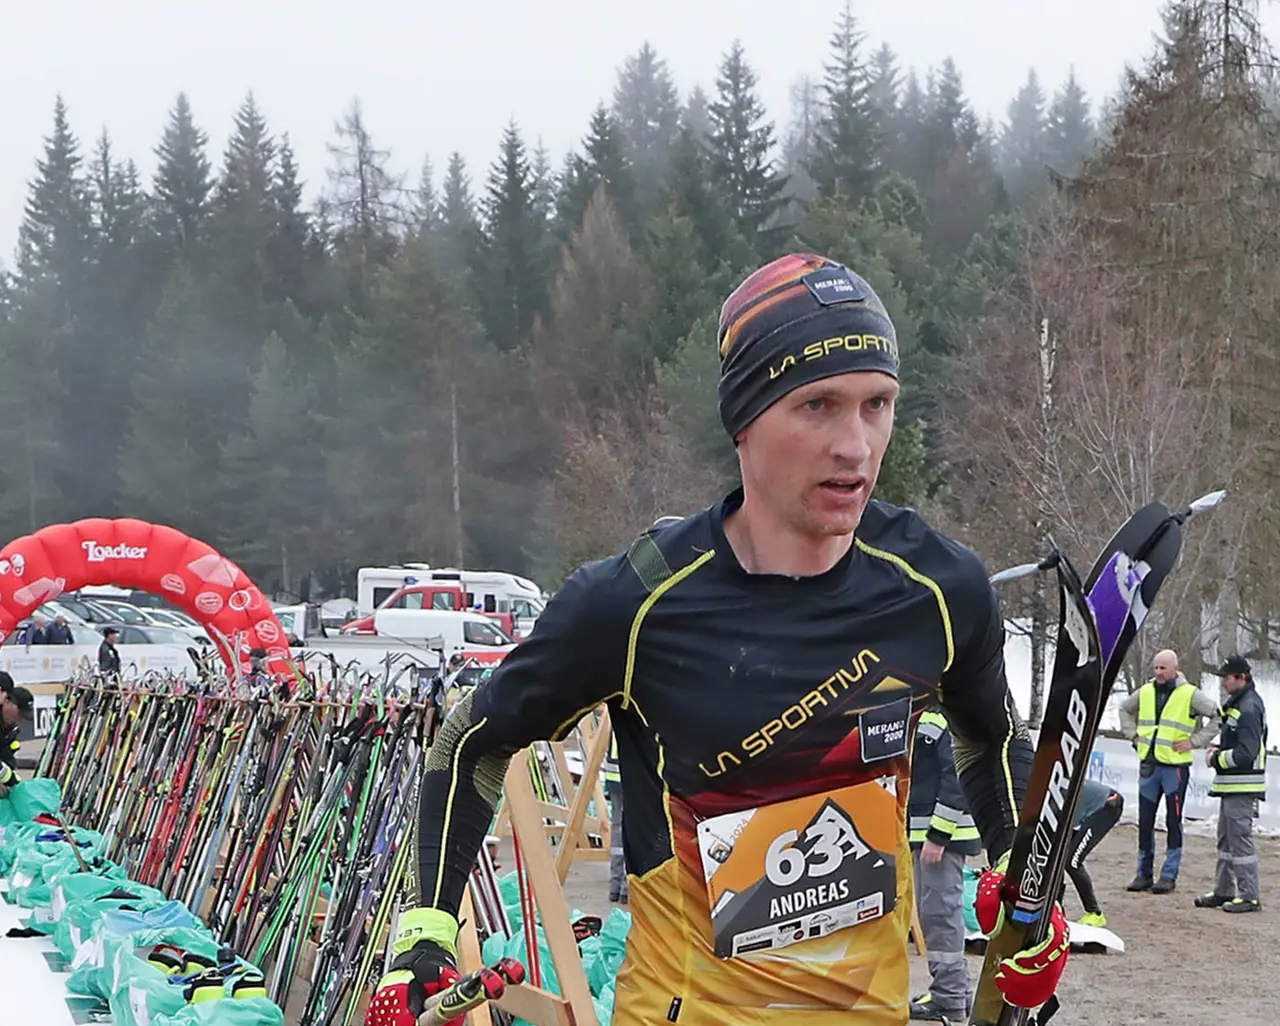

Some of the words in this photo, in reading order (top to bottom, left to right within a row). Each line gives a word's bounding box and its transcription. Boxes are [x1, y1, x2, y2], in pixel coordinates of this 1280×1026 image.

[769, 355, 796, 379] LA
[803, 334, 899, 362] SPORTI
[81, 541, 148, 562] Loacker
[698, 751, 742, 777] LA
[742, 649, 881, 758] SPORTIVA
[867, 720, 905, 737] MERANO
[884, 729, 904, 743] 2000
[765, 821, 845, 886] 63
[770, 879, 850, 919] ANDREAS
